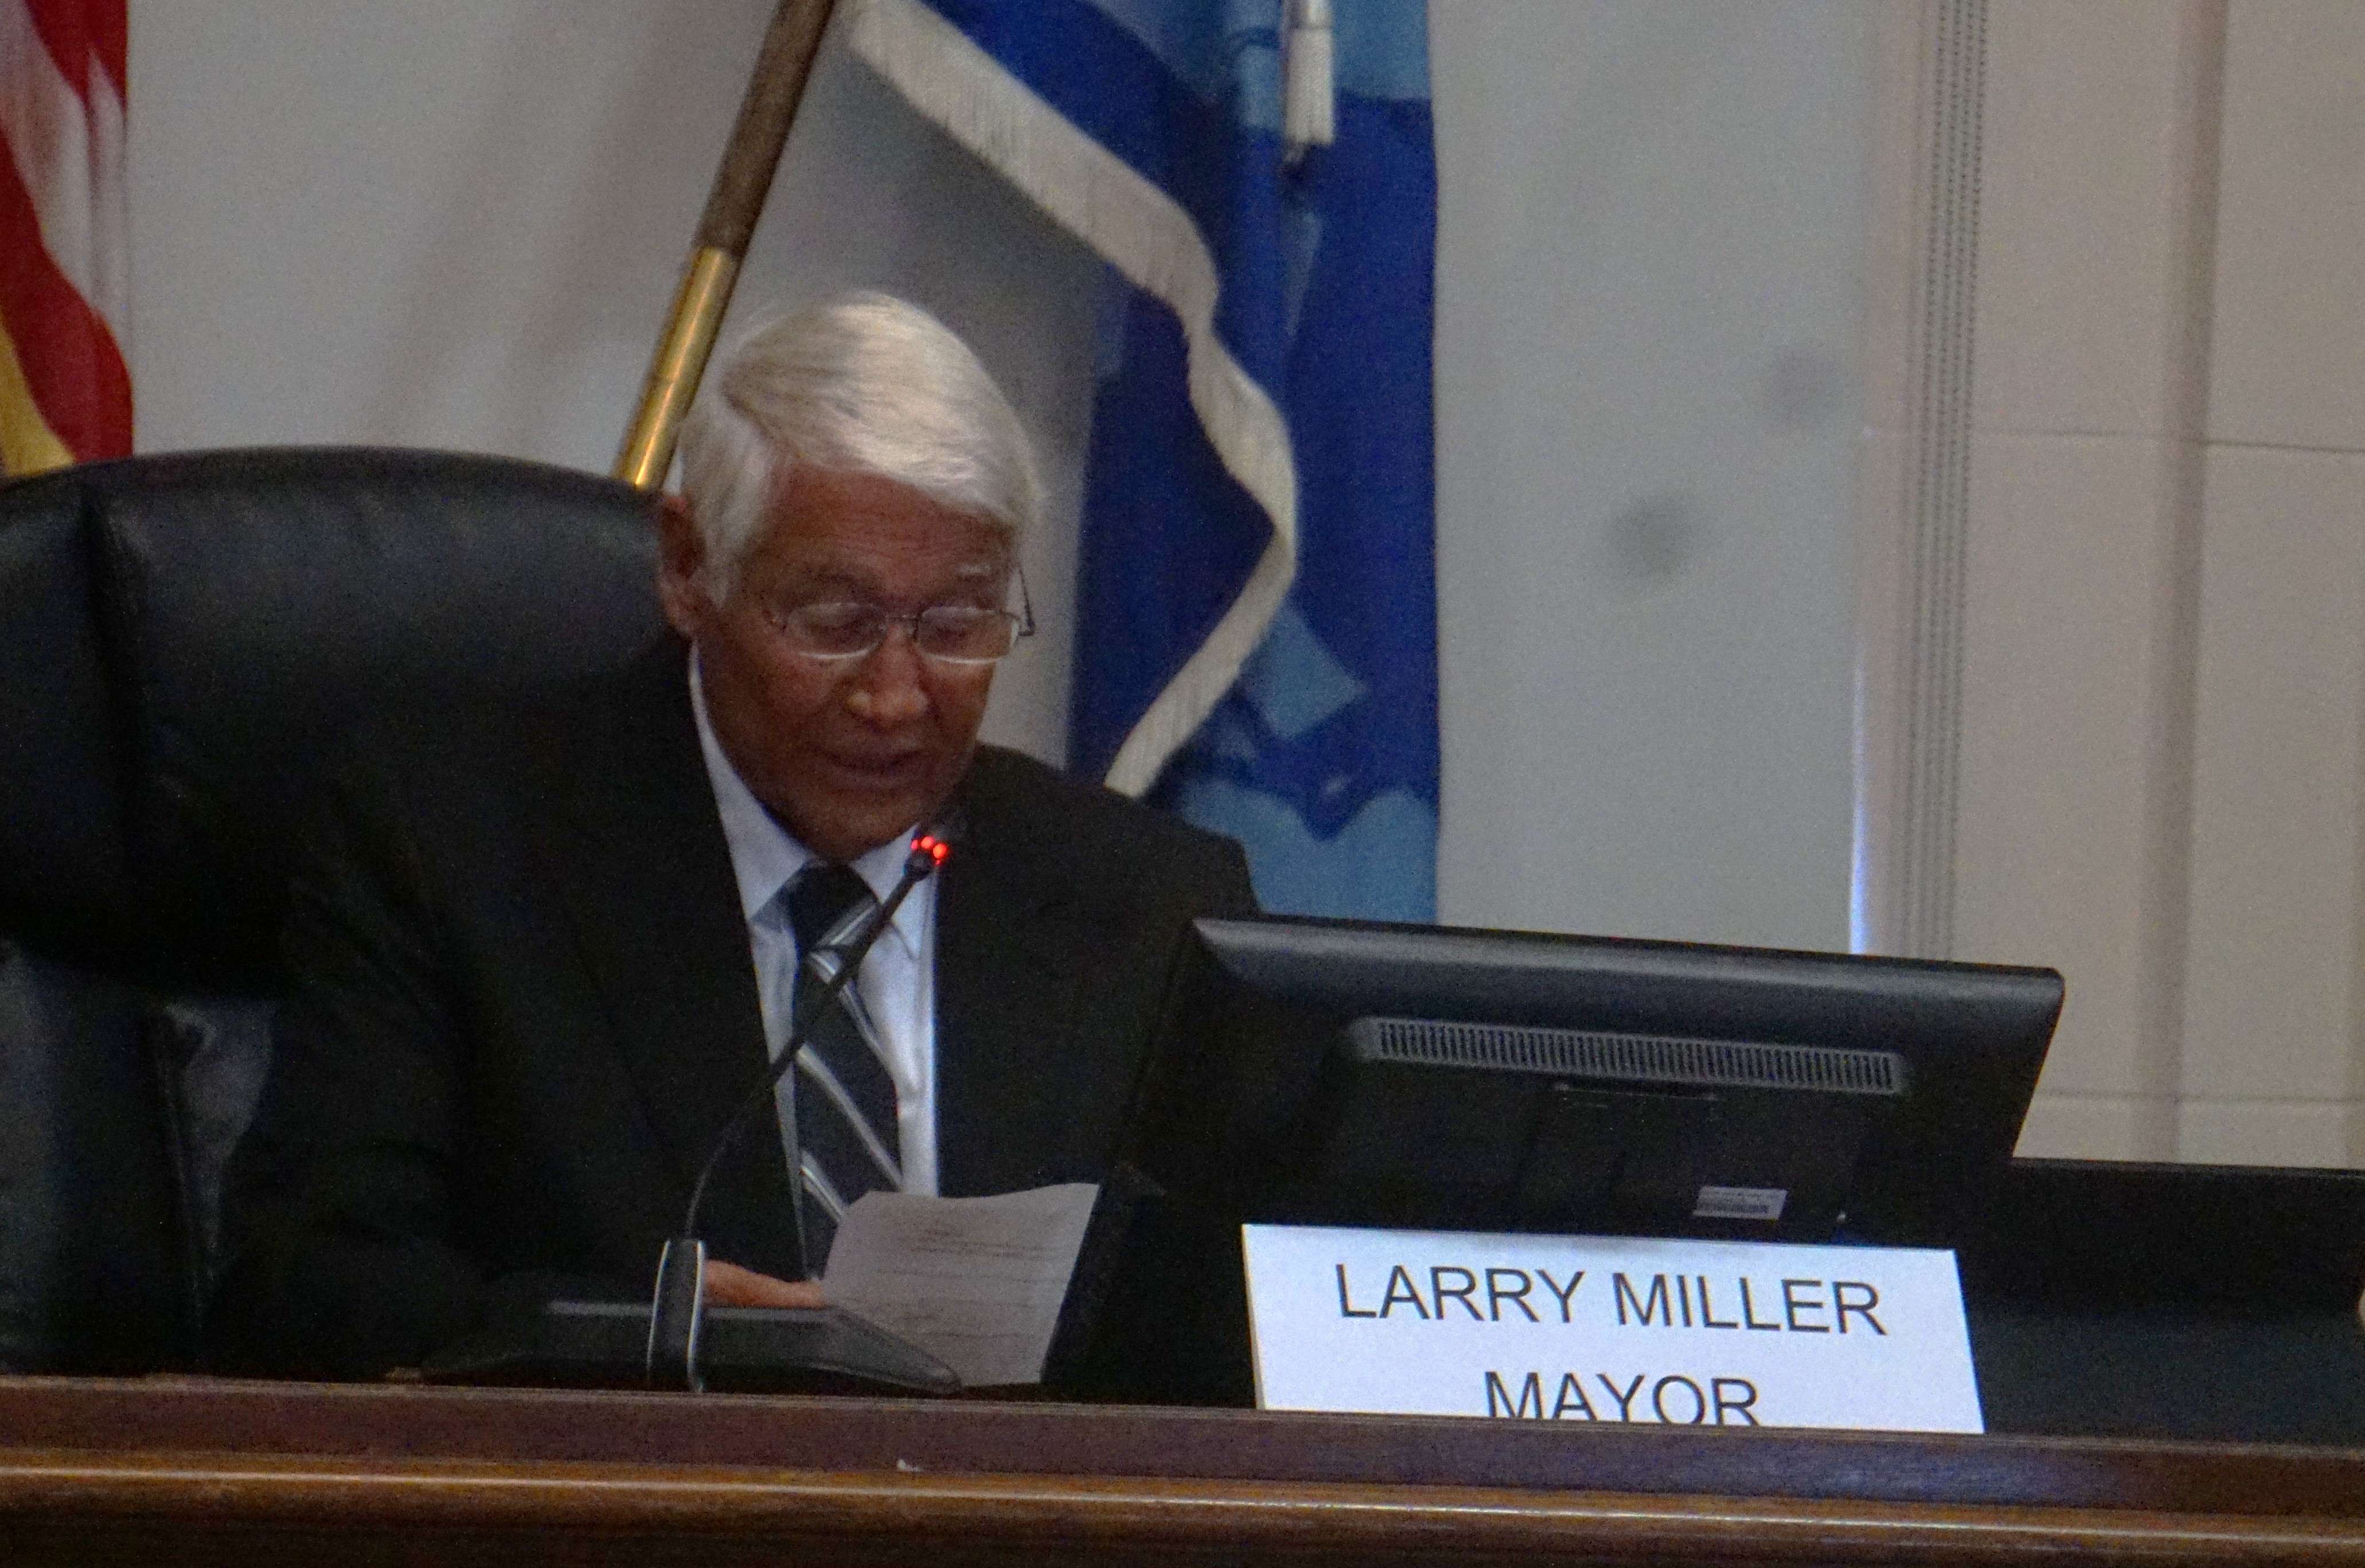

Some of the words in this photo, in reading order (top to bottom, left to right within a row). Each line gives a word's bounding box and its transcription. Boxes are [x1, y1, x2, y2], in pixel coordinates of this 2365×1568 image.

[1335, 1264, 1585, 1323] LARRY
[1612, 1272, 1887, 1336] MILLER
[1485, 1371, 1759, 1425] MAYOR
